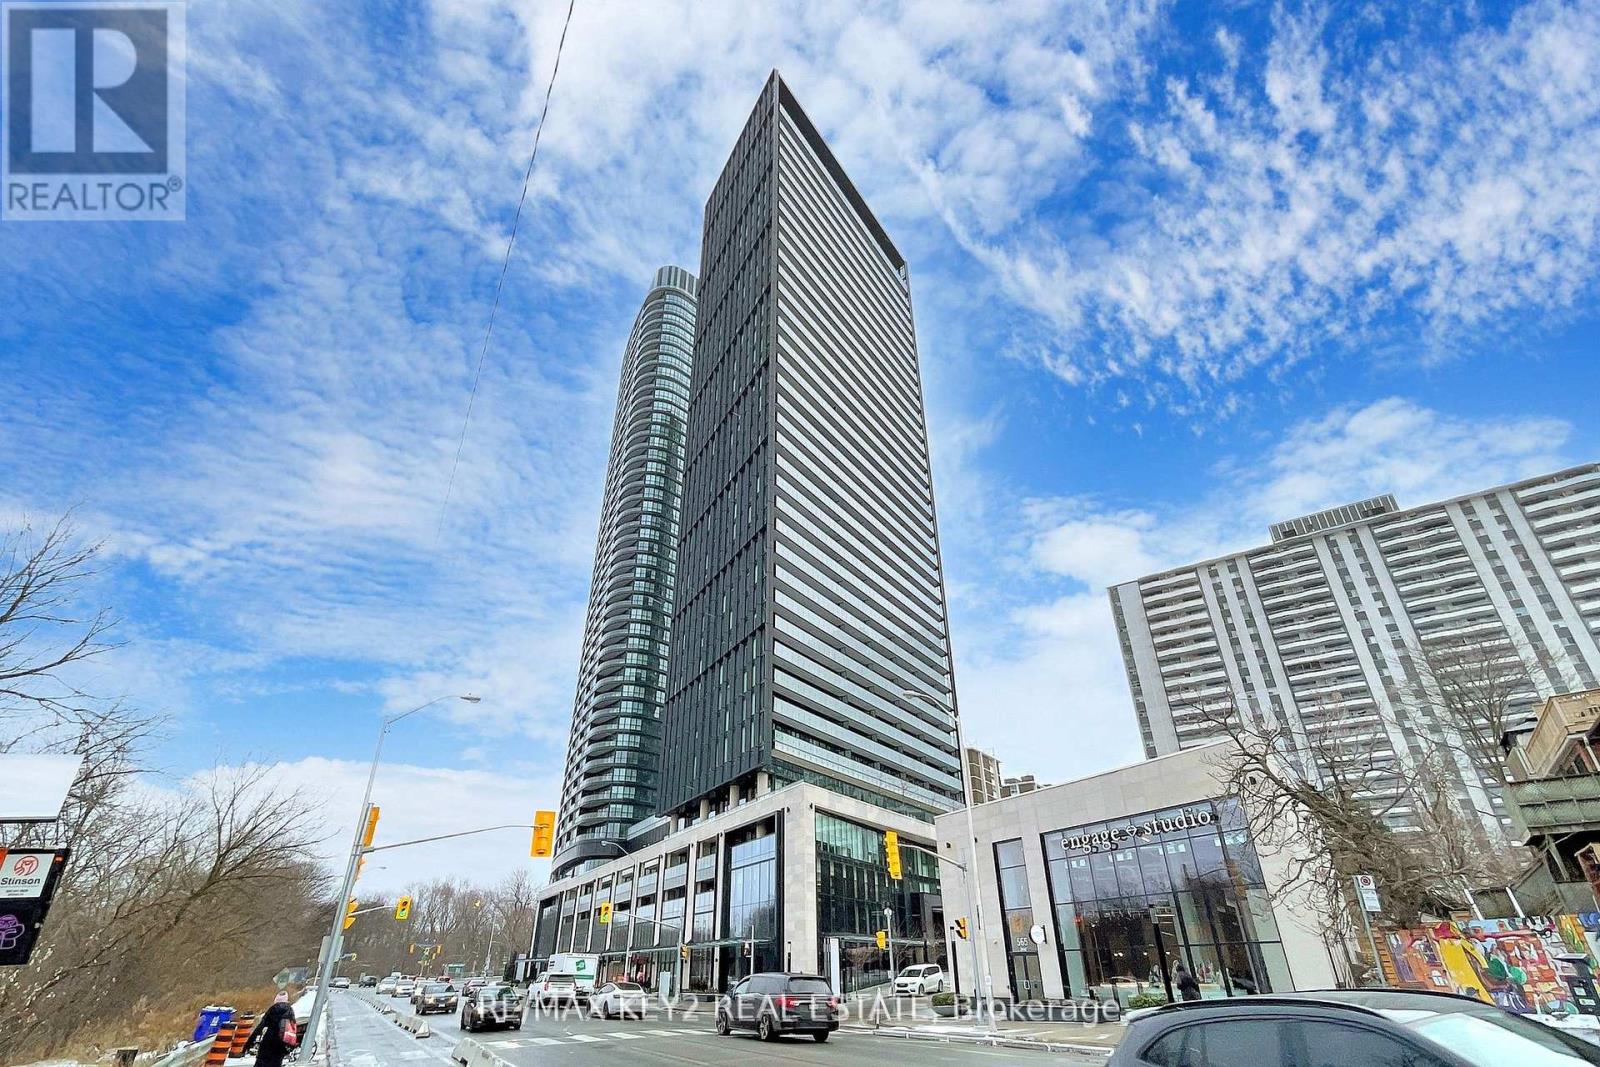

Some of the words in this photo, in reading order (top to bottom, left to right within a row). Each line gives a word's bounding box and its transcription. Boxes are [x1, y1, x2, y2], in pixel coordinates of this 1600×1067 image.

[1061, 827, 1121, 853] engage
[1143, 807, 1211, 835] studio
[0, 877, 41, 885] Stinson
